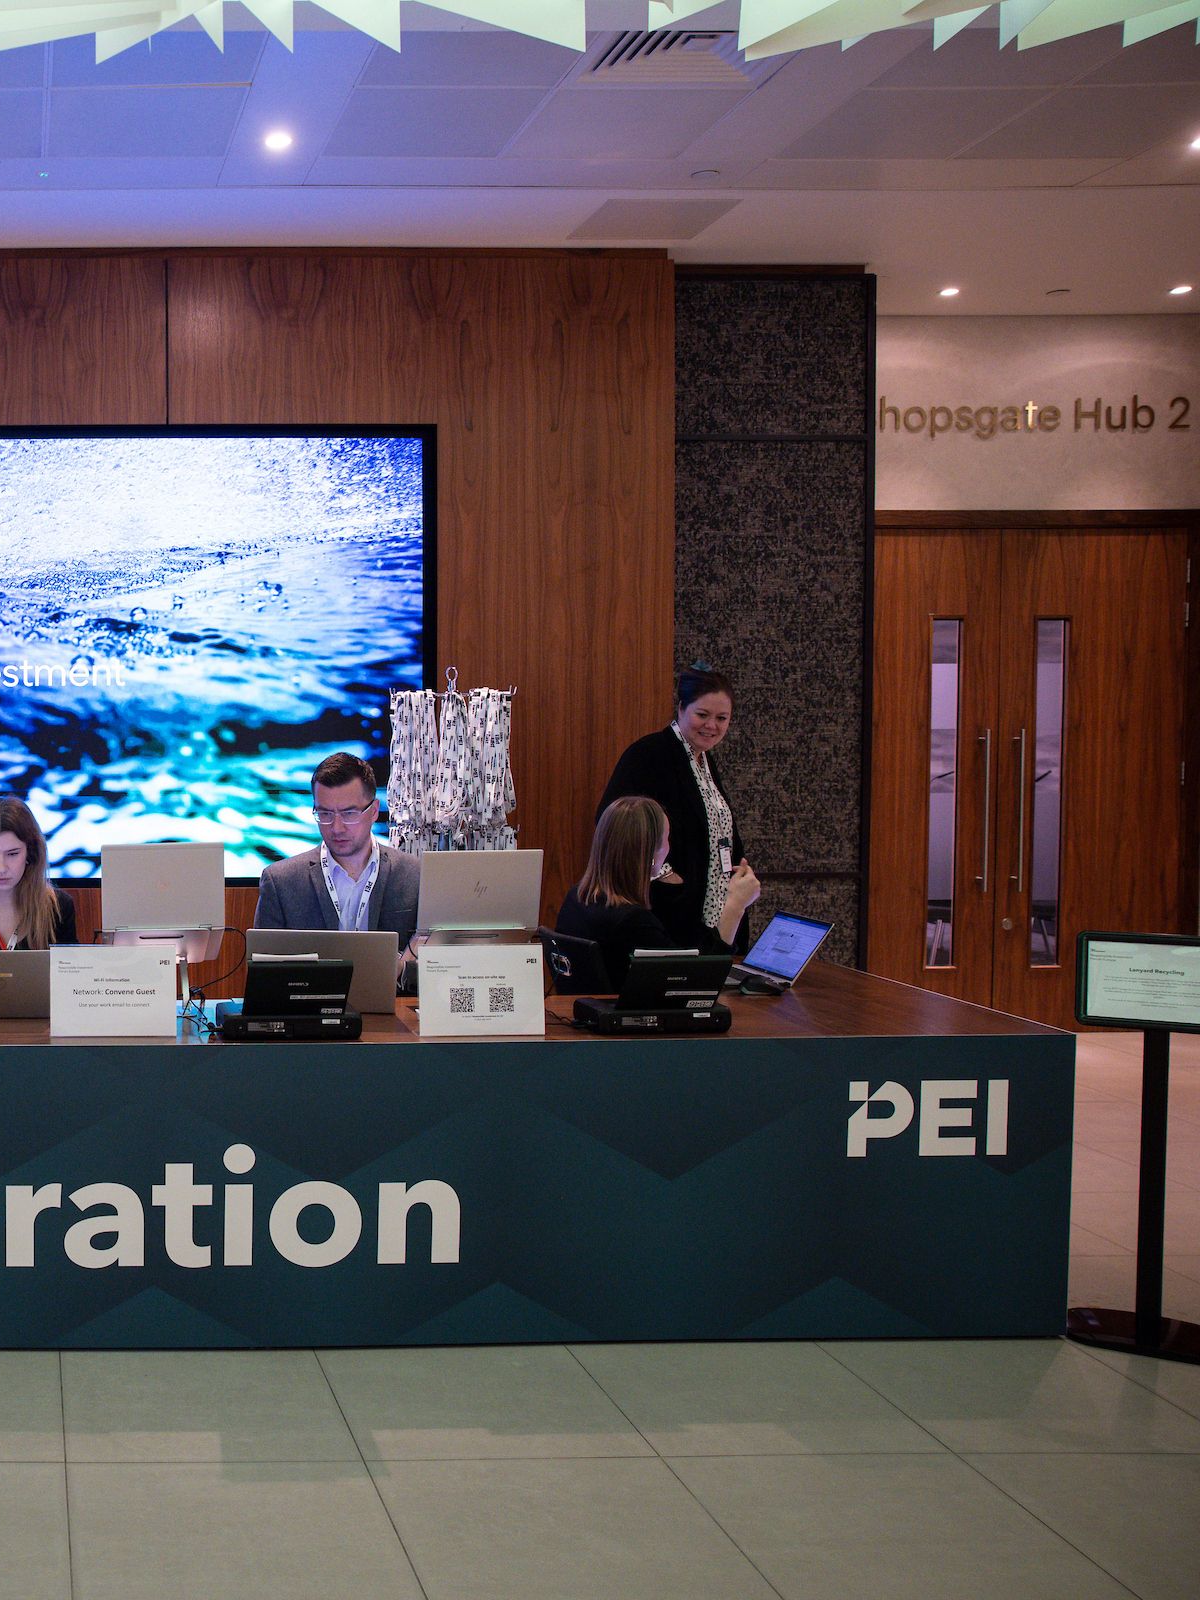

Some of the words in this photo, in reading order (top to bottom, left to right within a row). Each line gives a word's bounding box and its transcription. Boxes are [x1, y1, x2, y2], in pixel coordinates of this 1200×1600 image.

[878, 396, 1062, 441] hopsgate
[1074, 394, 1156, 432] Hub
[1168, 397, 1191, 431] 2
[364, 881, 373, 893] PEI
[1154, 968, 1185, 976] Recycling
[846, 1078, 1010, 1158] PEI
